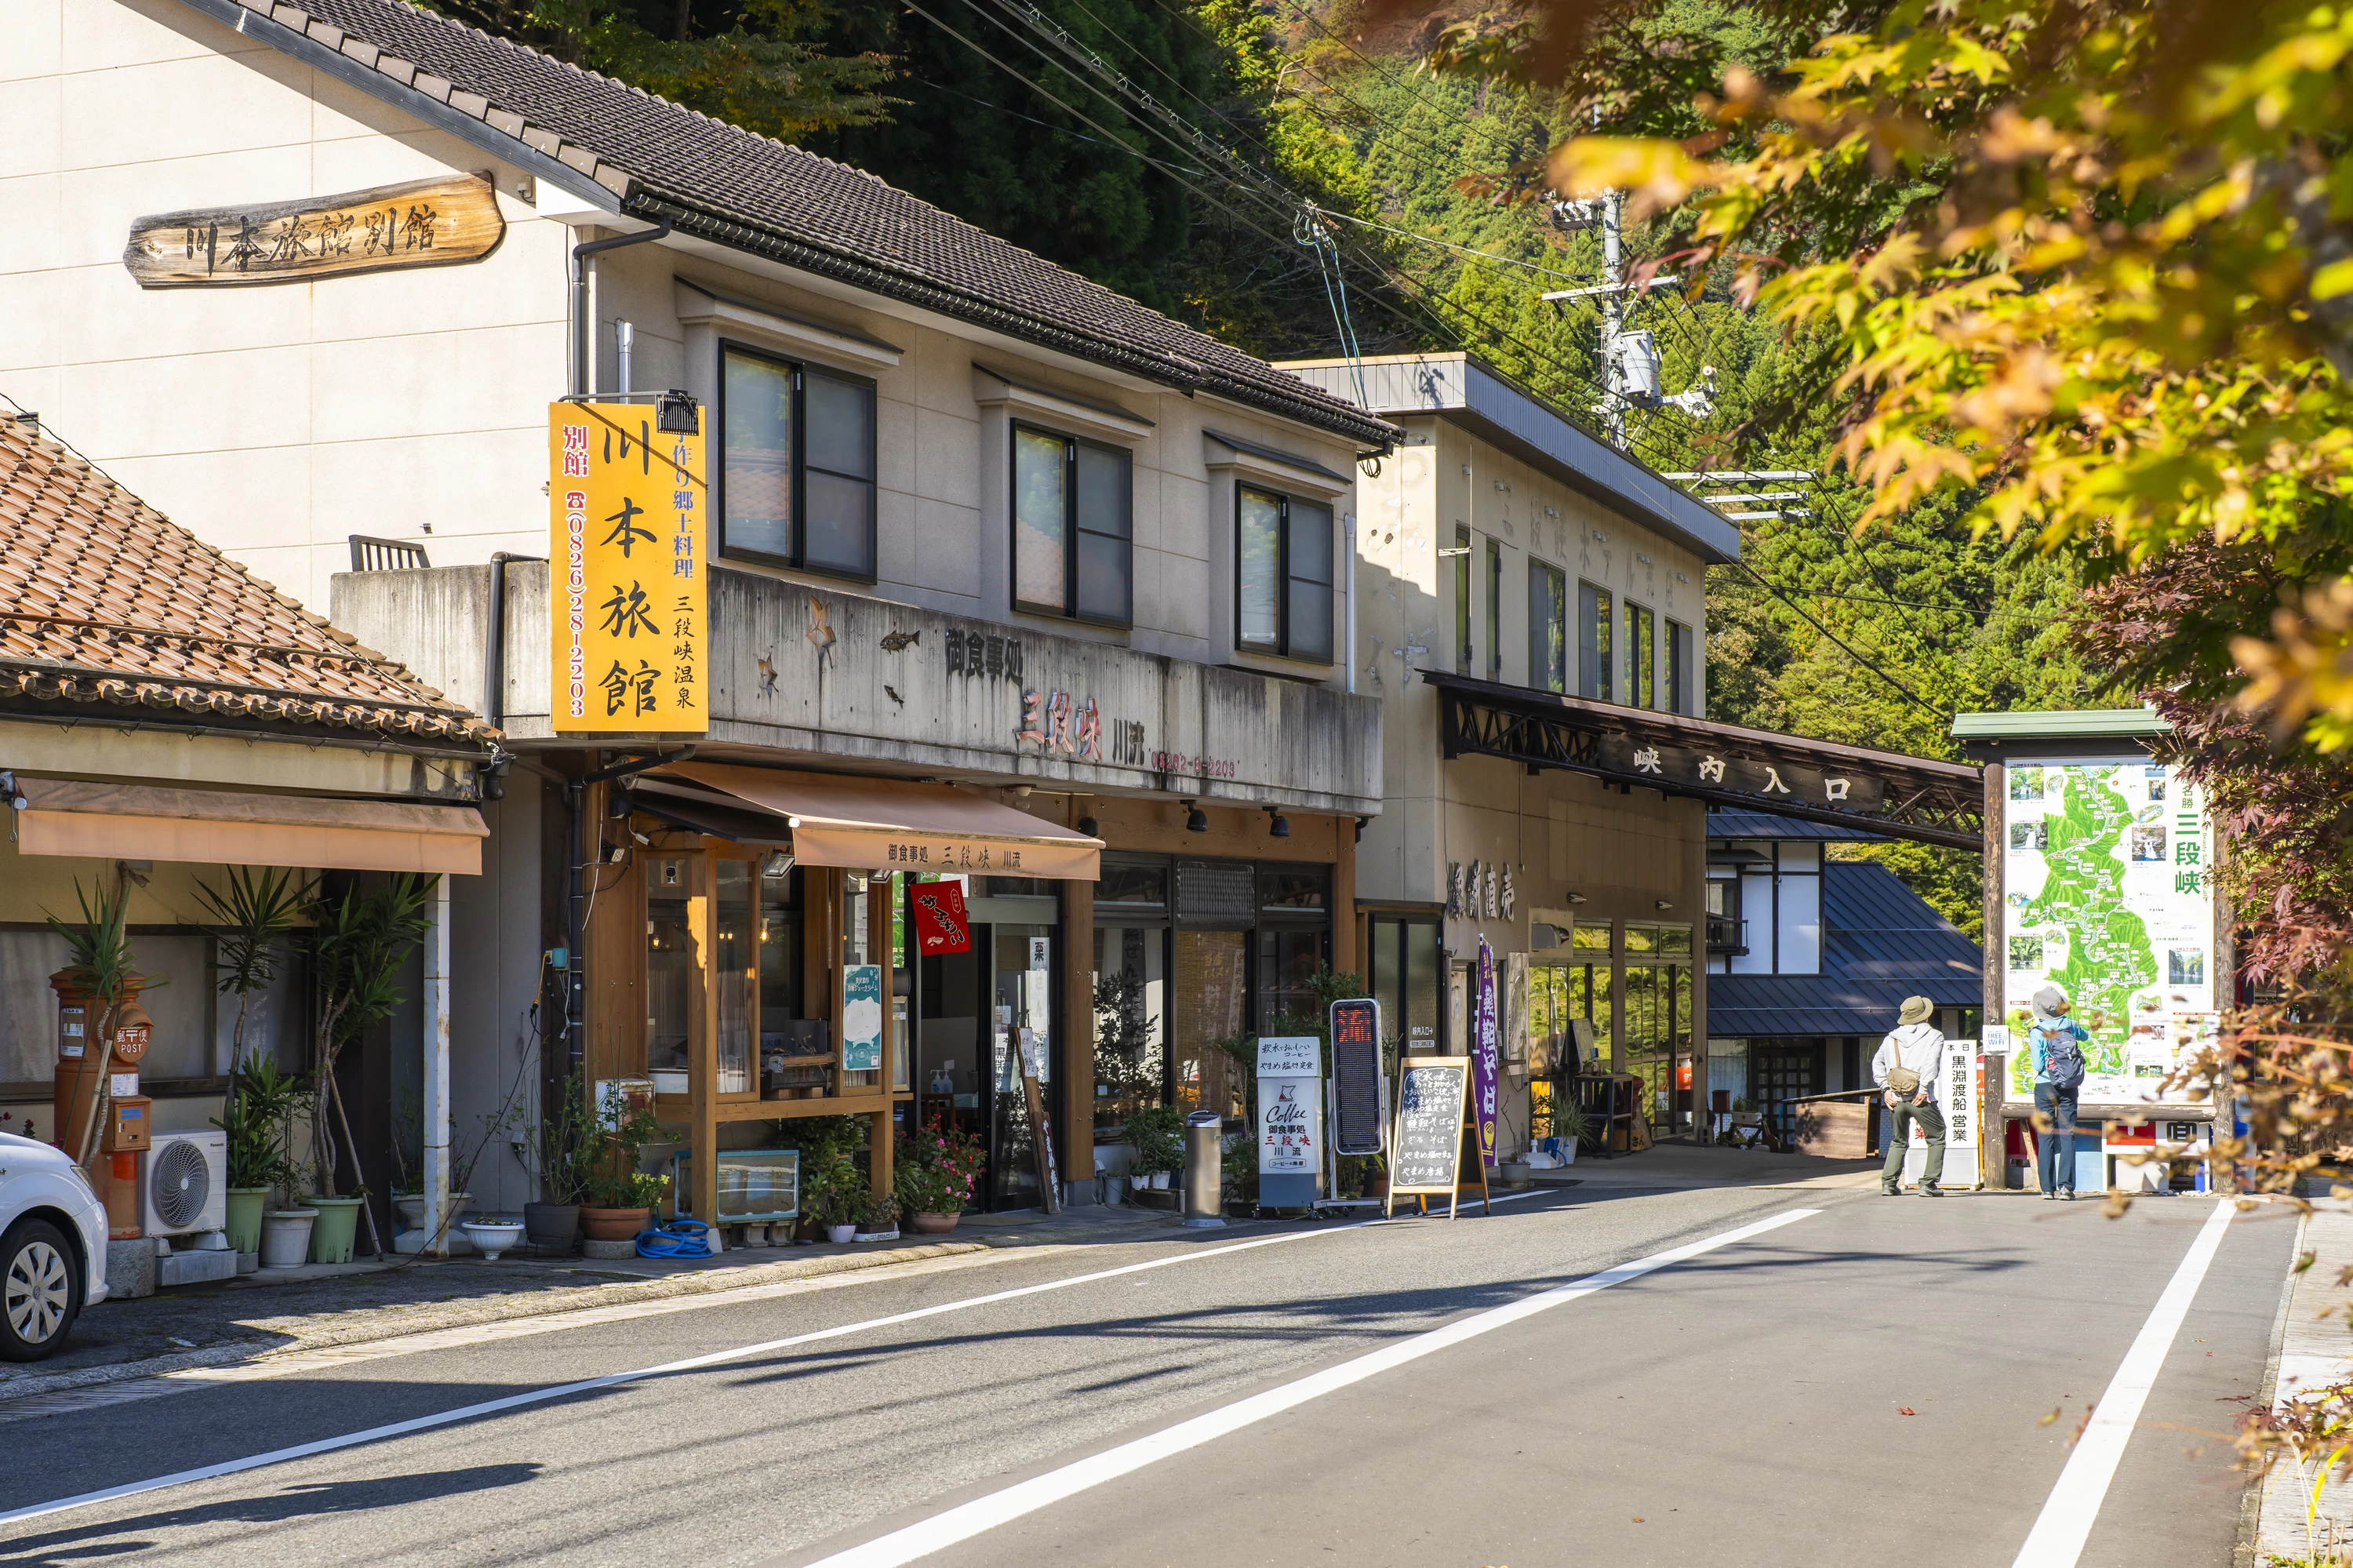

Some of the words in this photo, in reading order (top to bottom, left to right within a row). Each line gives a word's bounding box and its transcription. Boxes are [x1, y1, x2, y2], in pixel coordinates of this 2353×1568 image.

[187, 205, 436, 277] 川本旅館別館
[563, 425, 590, 477] 別館
[598, 420, 661, 718] 川本旅館
[672, 595, 696, 709] 三段峡温泉
[946, 628, 1023, 686] 御食事処
[1016, 691, 1102, 761] 三段峡
[1151, 751, 1235, 778] 08262-8-2203
[1634, 746, 1851, 802] 峡内入口
[888, 843, 929, 863] 御食事処
[941, 846, 991, 869] 三段峡
[1003, 849, 1020, 868] 川流
[2175, 814, 2201, 895] 三段峡
[121, 1043, 142, 1053] POST
[1951, 1056, 1967, 1111] 黒淵渡船
[1265, 1103, 1307, 1123] Coffee
[1268, 1125, 1306, 1134] 御食事処
[1951, 1115, 1968, 1142] 営業
[1264, 1134, 1311, 1147] 三段峡
[1274, 1147, 1301, 1157] 川流
